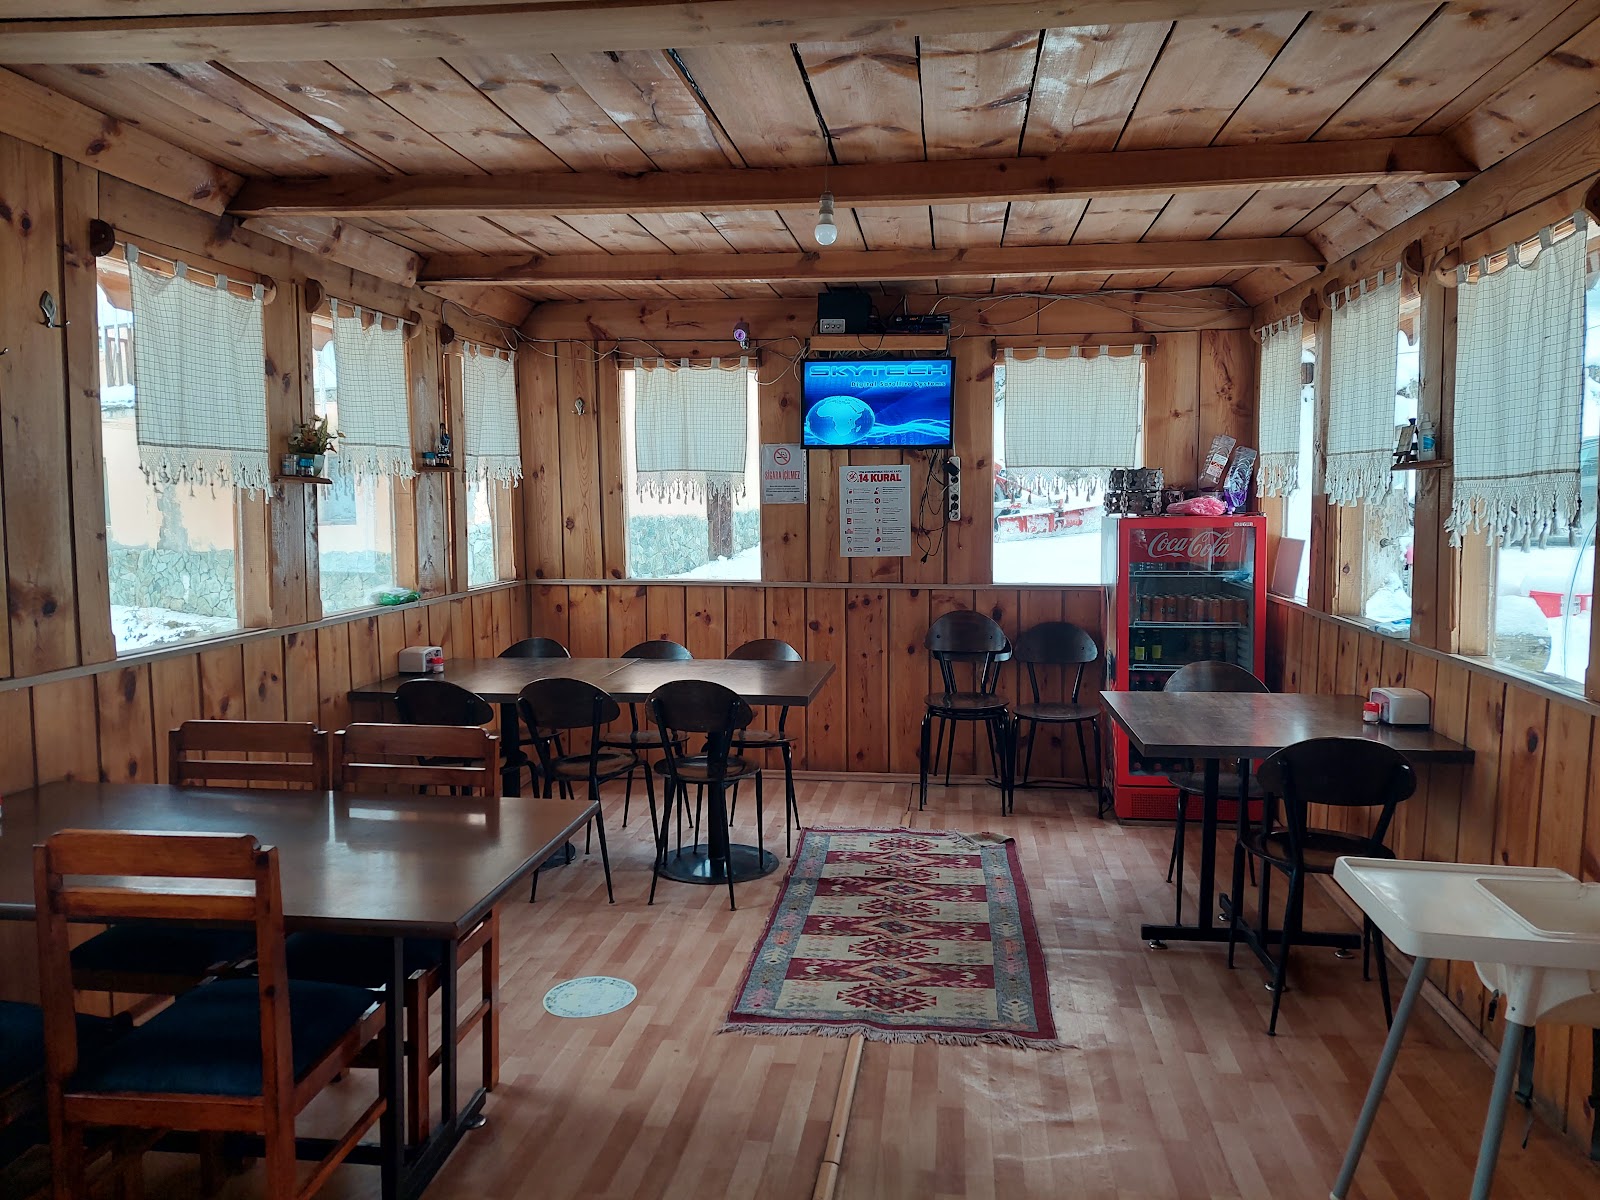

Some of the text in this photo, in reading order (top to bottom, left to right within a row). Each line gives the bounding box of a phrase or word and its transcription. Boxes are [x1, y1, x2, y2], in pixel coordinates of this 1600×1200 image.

[809, 364, 948, 377] SKYTECH
[859, 473, 902, 482] 14 KURAL
